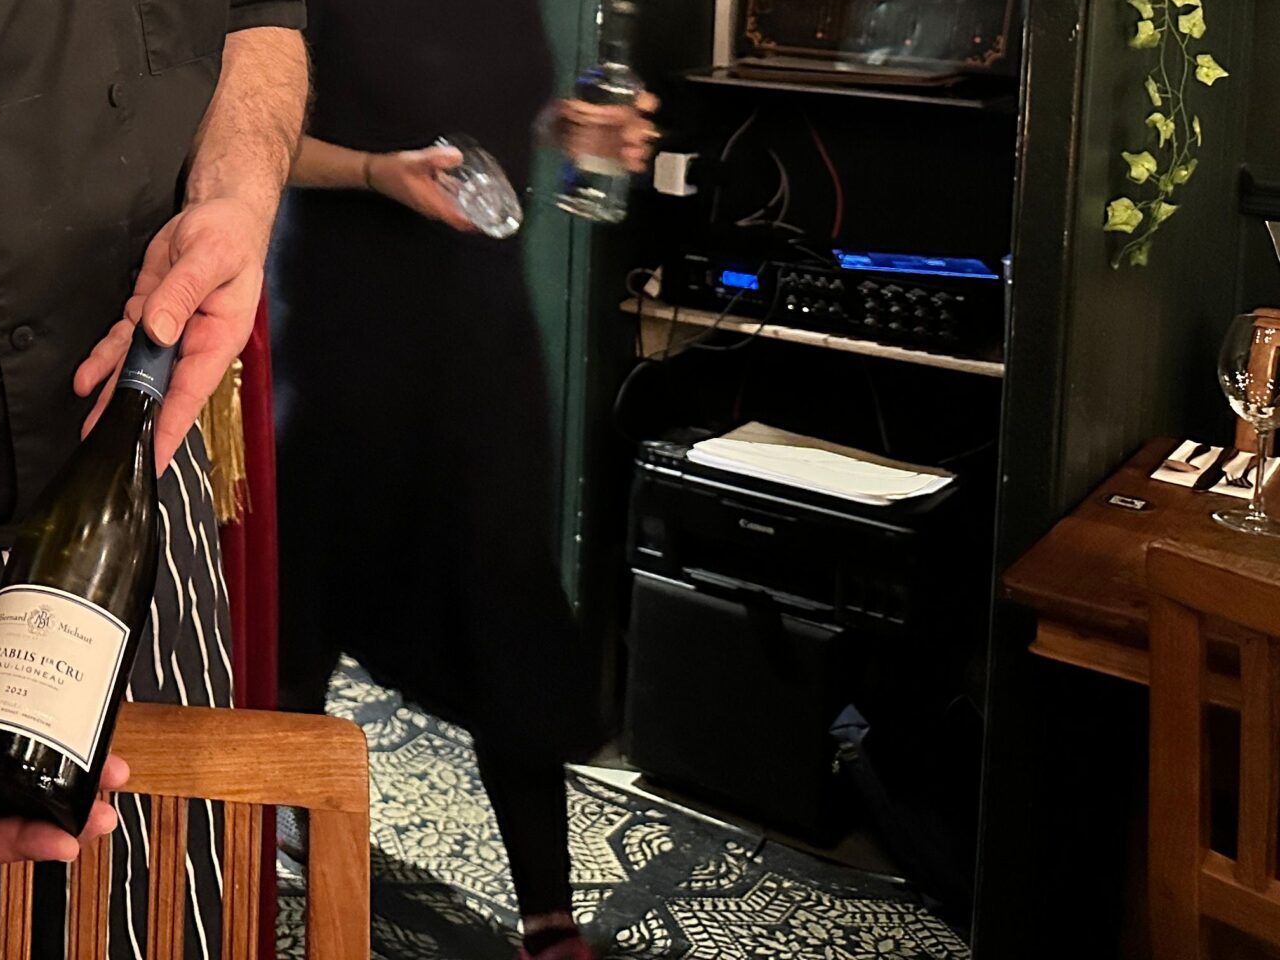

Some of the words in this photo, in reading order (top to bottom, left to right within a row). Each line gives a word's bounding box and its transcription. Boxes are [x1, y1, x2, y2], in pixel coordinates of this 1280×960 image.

[0, 612, 28, 622] Bernard
[58, 622, 93, 644] Michaut
[55, 660, 84, 682] CRU
[5, 686, 28, 697] 2023
